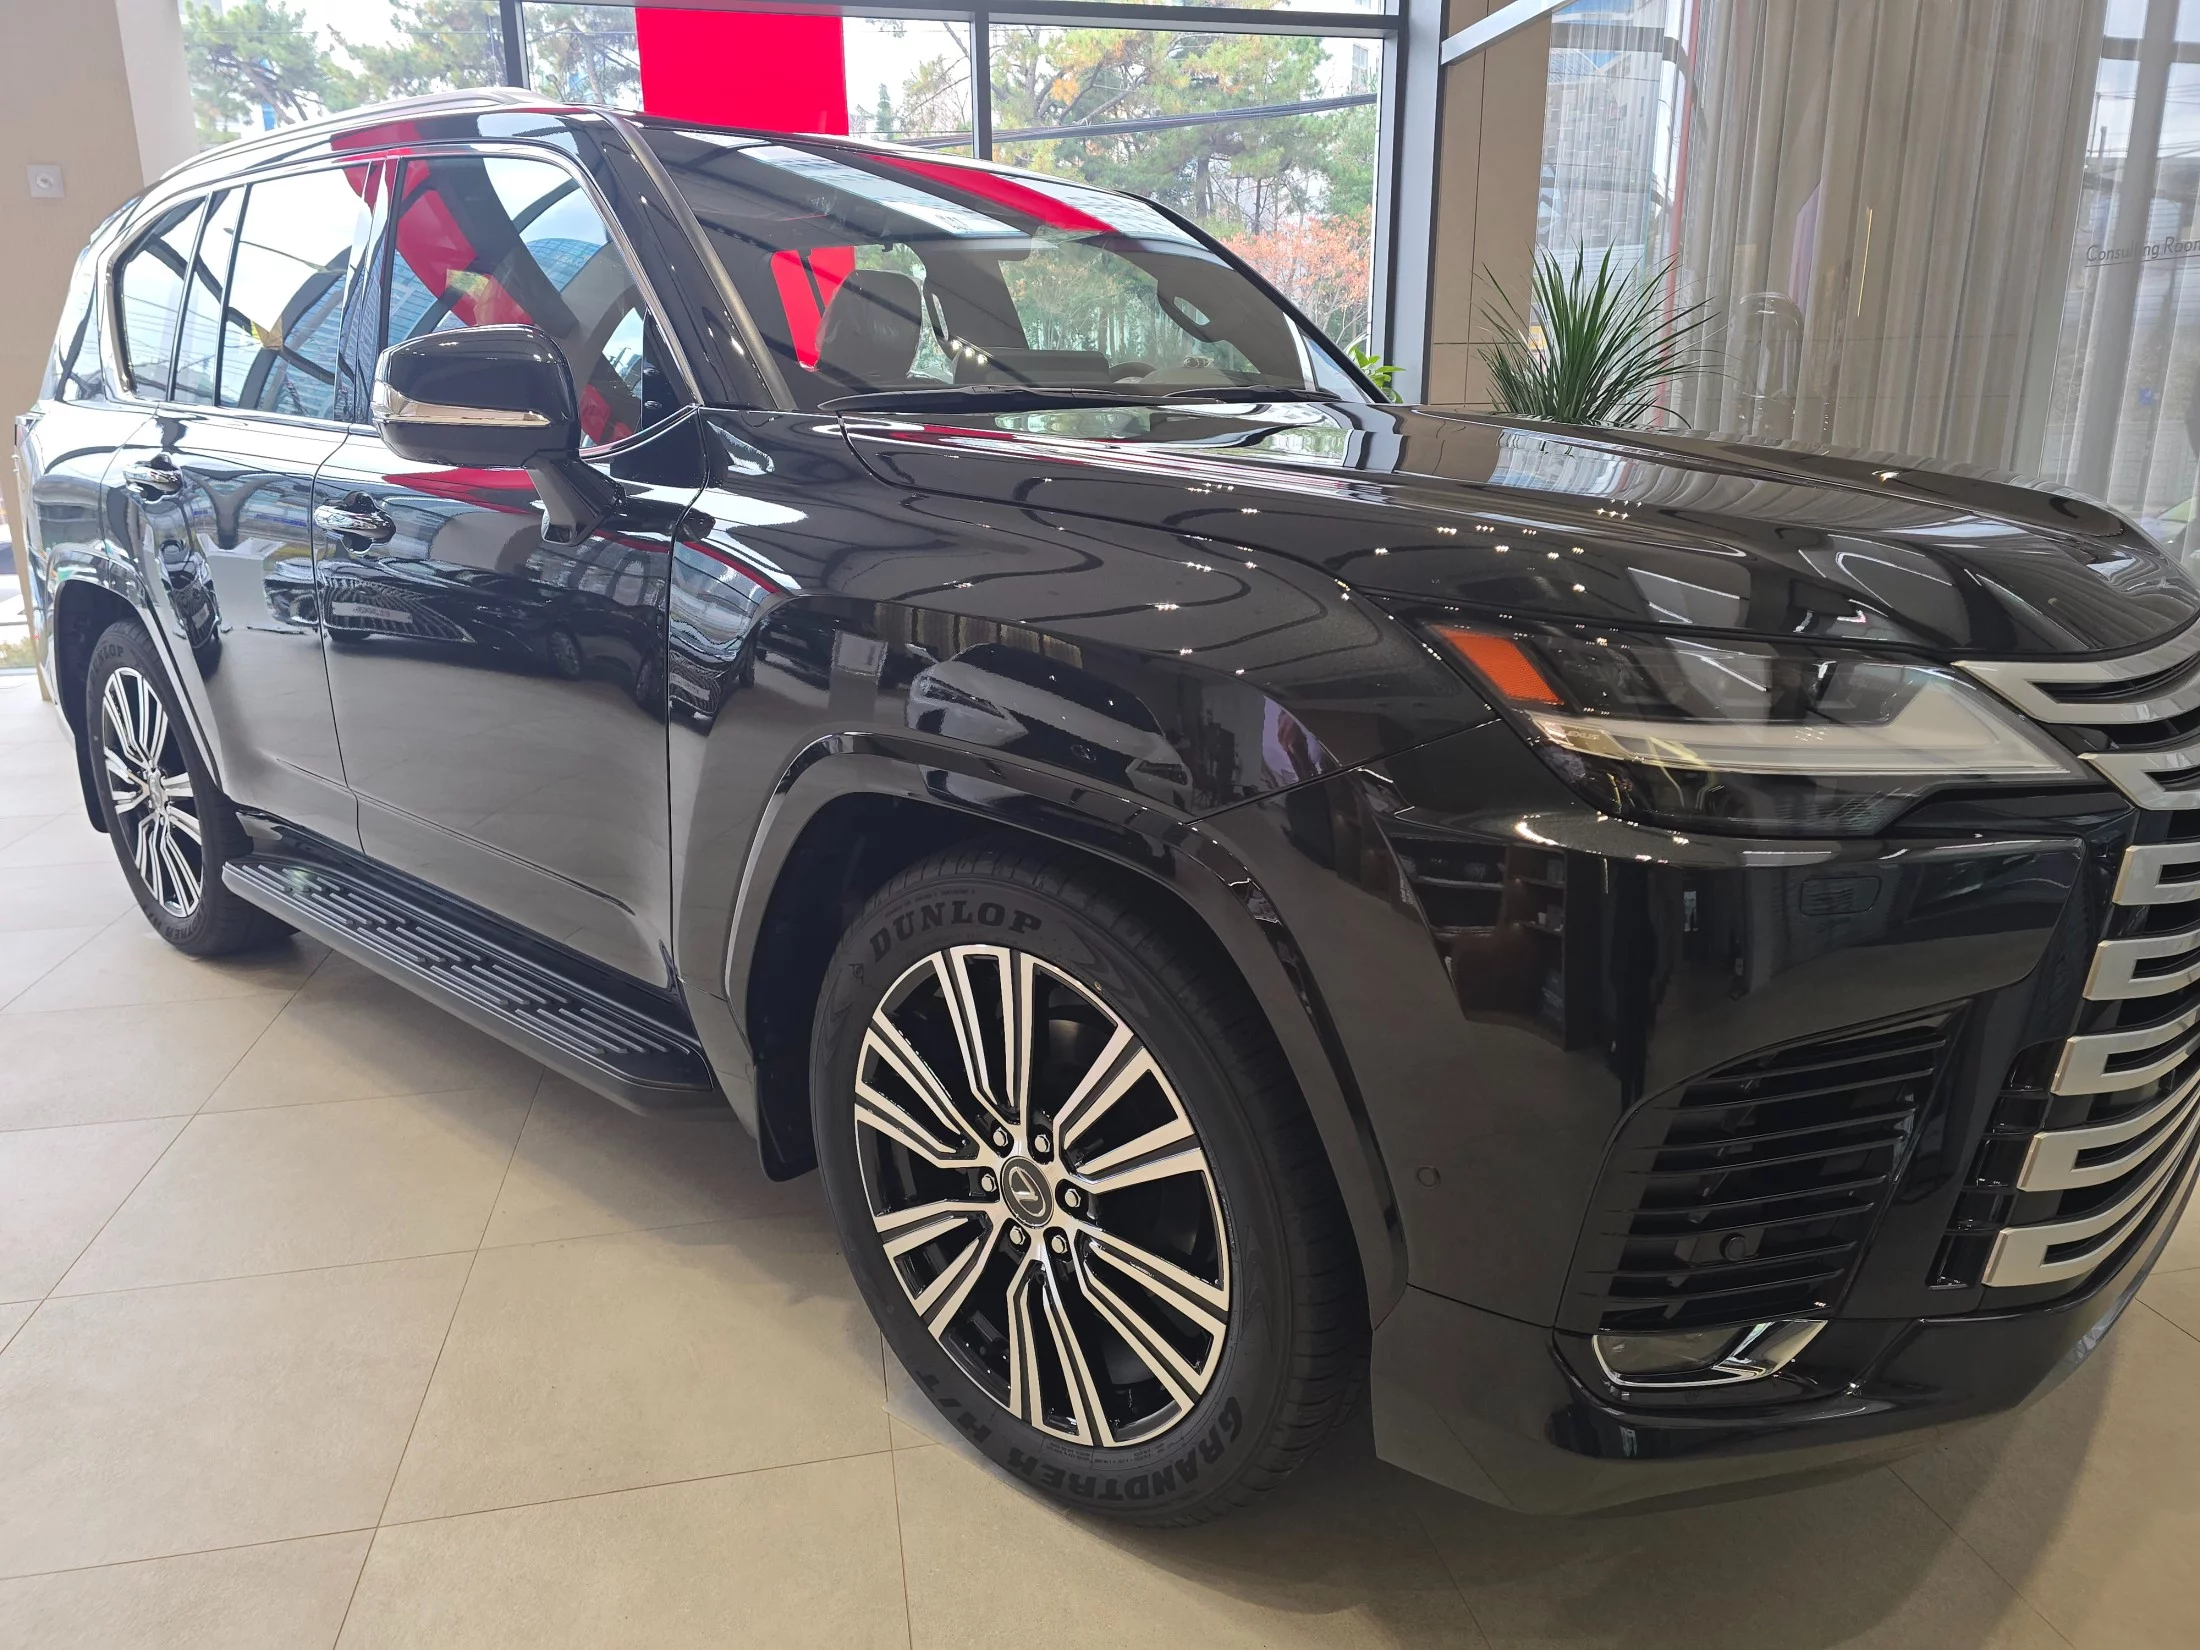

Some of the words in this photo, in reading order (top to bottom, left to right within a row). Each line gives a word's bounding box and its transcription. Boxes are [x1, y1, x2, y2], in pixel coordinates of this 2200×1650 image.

[2086, 240, 2161, 261] Consulng
[869, 900, 1043, 964] DUNLOP
[1006, 1396, 1243, 1501] GRANDTREK
